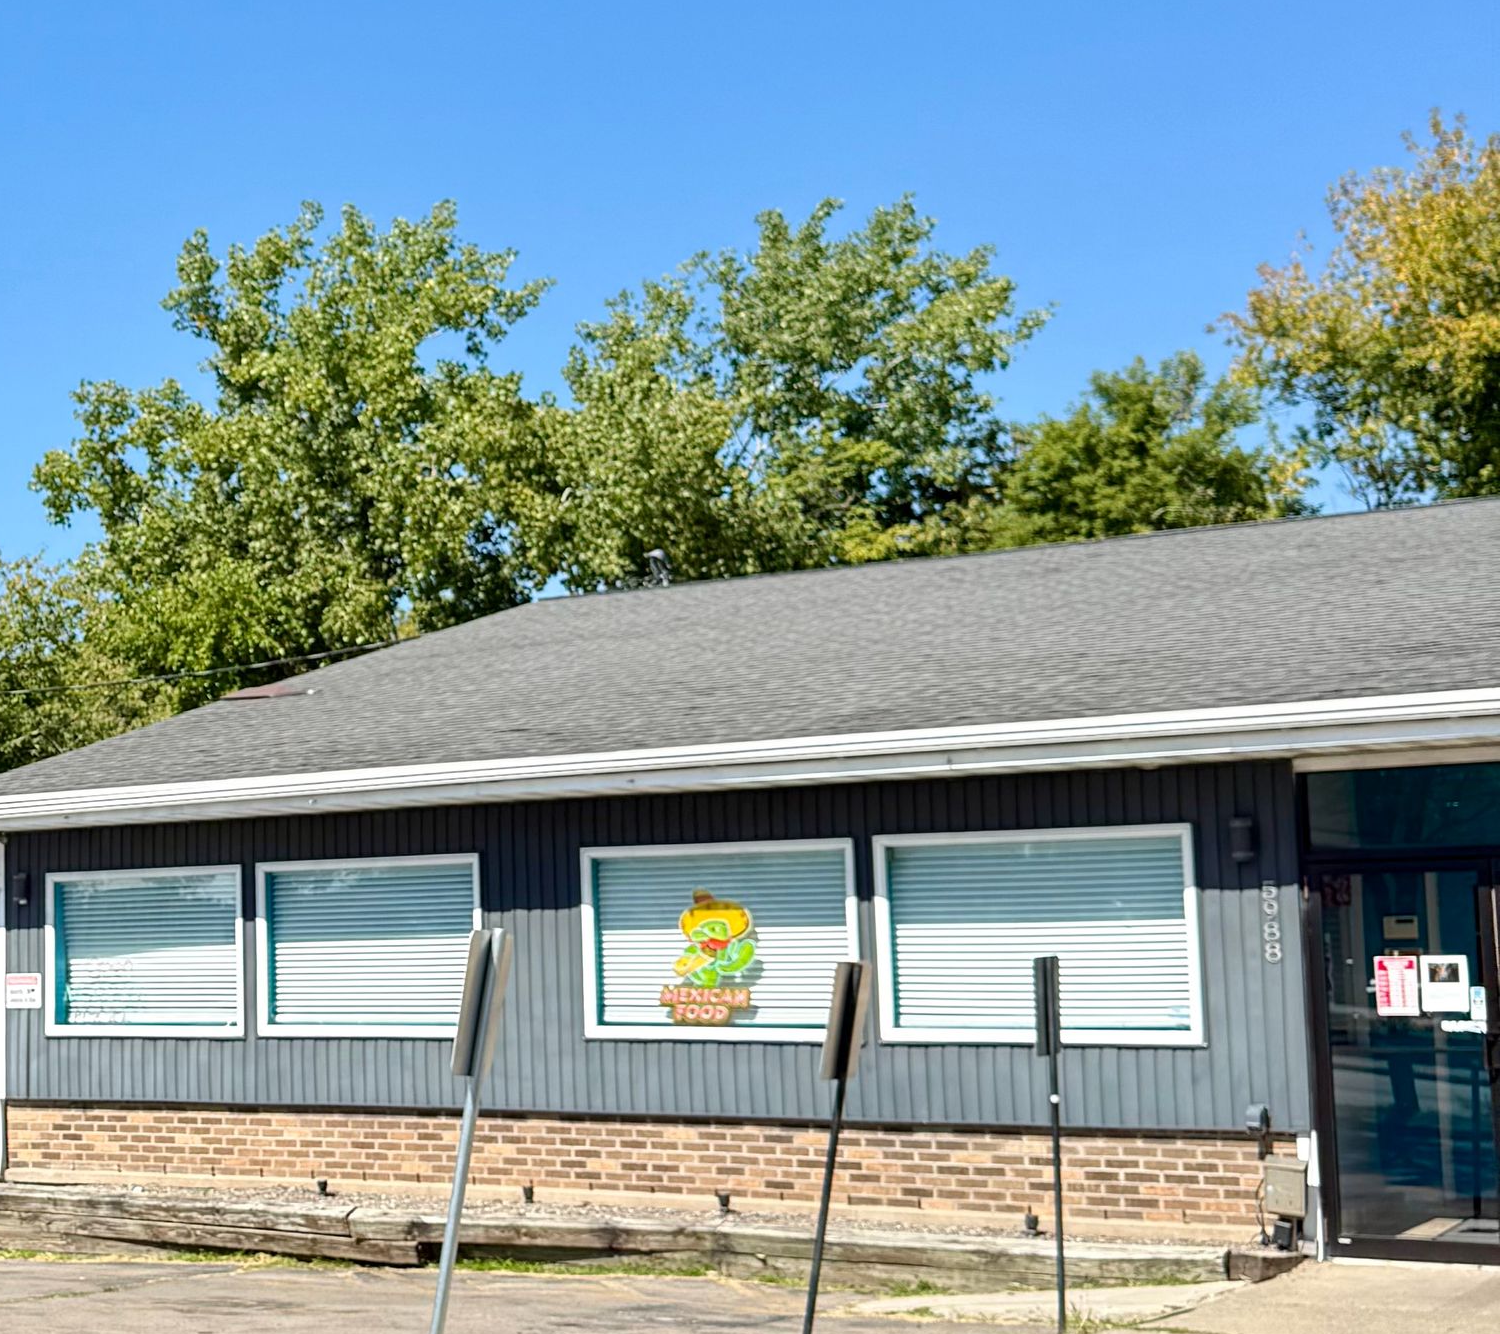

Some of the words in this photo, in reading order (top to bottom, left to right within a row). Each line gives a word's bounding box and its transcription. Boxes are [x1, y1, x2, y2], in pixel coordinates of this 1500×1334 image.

[1261, 879, 1283, 964] 5988
[660, 985, 750, 1008] MEXICAN
[674, 1003, 730, 1021] FOOD
